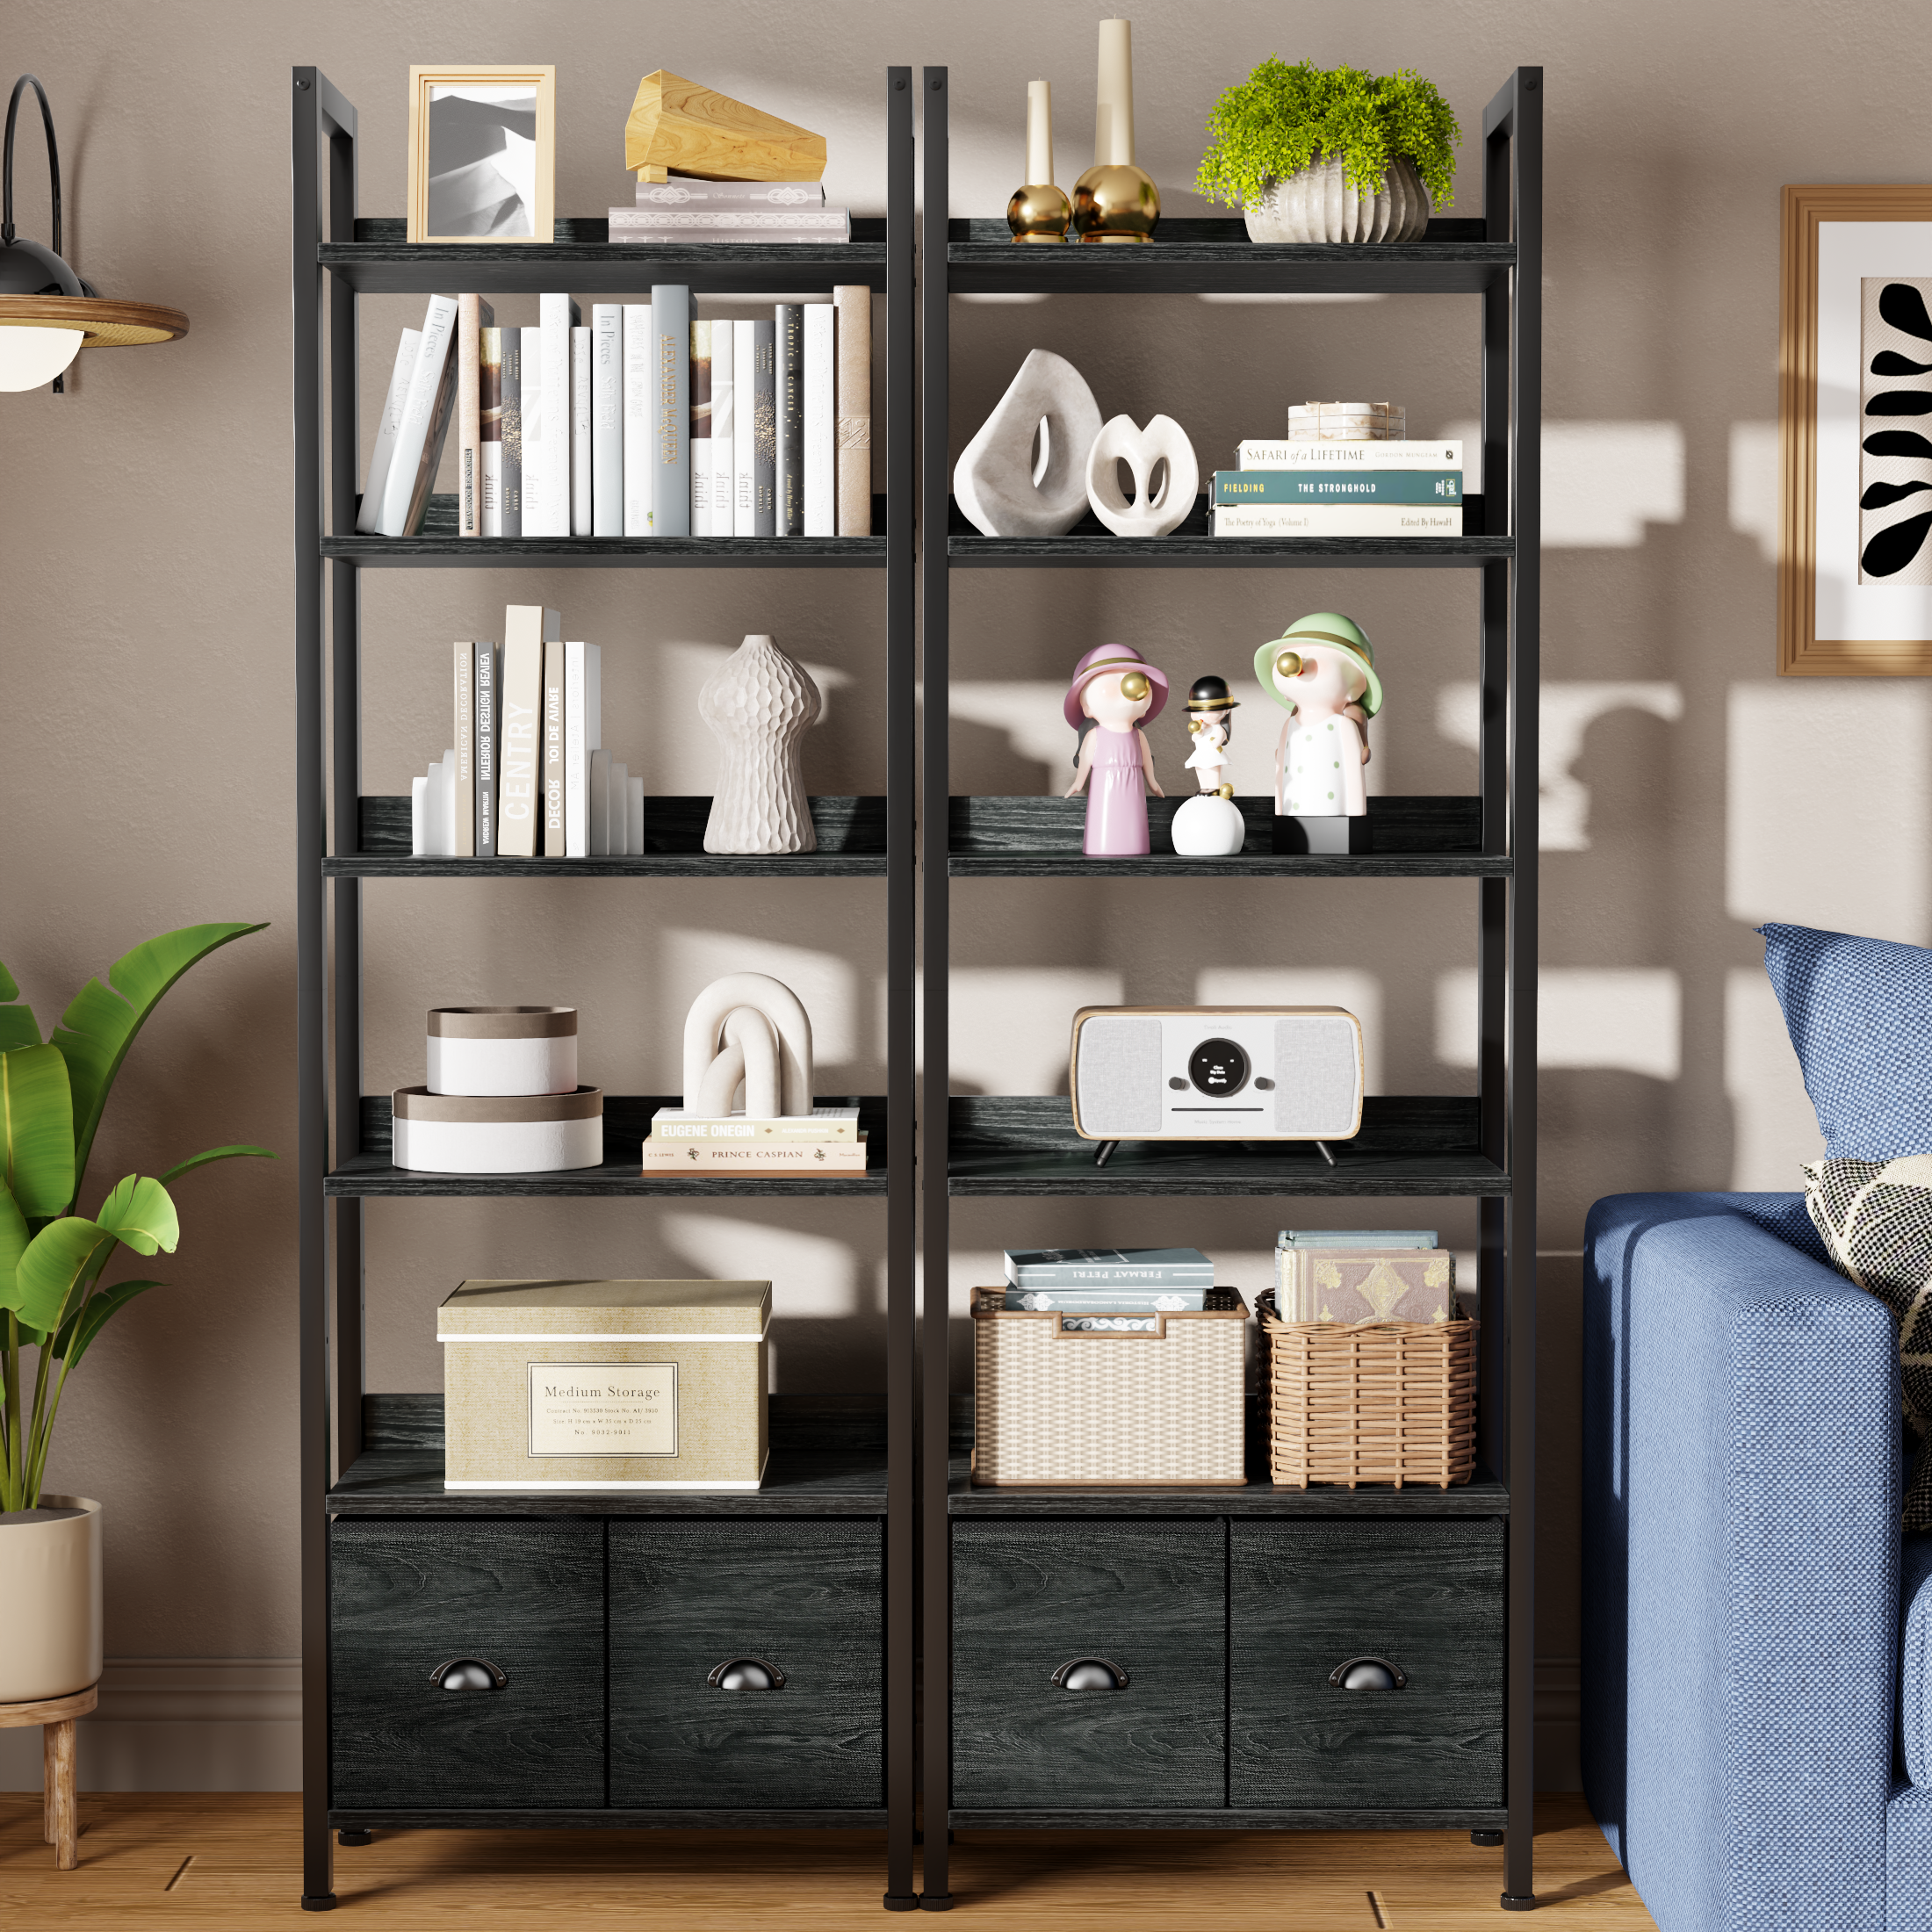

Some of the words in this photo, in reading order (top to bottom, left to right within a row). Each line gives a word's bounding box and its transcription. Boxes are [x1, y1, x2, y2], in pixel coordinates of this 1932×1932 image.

[434, 307, 449, 319] In
[600, 315, 615, 326] In
[424, 323, 445, 358] Pieces
[600, 331, 615, 365] Pieces
[660, 334, 676, 406] ALEXANDER
[599, 375, 616, 400] Sally
[407, 398, 429, 425] Field
[600, 403, 616, 430] Field
[657, 408, 678, 465] McQUEEN
[1247, 449, 1287, 461] SAFARI
[1291, 449, 1301, 464] of
[1310, 449, 1365, 461] LIFETIME
[1224, 483, 1264, 493] FIELDING
[1298, 483, 1314, 493] THE
[1319, 483, 1376, 493] STRONGHOLD
[1224, 518, 1234, 526] The
[1236, 518, 1254, 528] Poetry
[1255, 518, 1261, 526] of
[1262, 518, 1276, 528] Yoga
[1279, 518, 1301, 527] (Volume
[1401, 518, 1420, 526] Edited
[1421, 519, 1429, 528] By
[505, 702, 533, 821] CENTRY
[661, 1125, 707, 1137] EUGENE
[711, 1125, 755, 1137] ONEGIN
[545, 1386, 601, 1397] Medium
[608, 1386, 660, 1400] Storage
